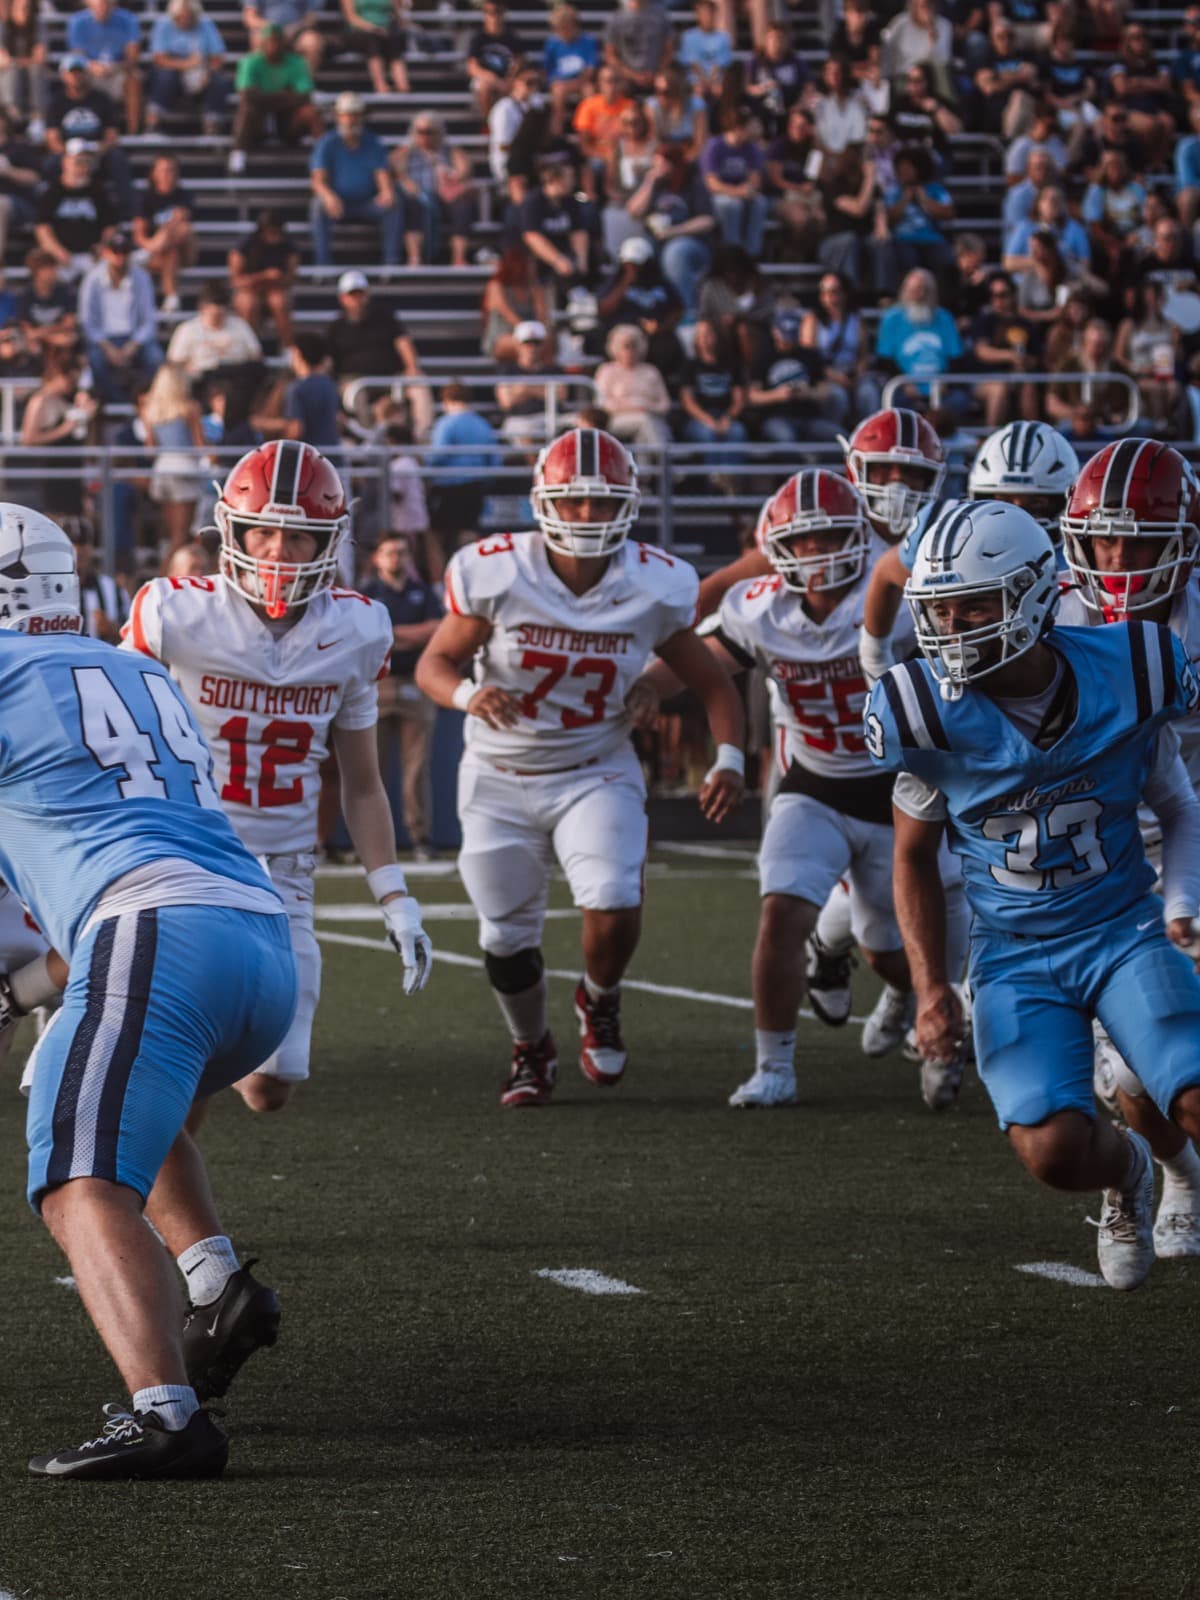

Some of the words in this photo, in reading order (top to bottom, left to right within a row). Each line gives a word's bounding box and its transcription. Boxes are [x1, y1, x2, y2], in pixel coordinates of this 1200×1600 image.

[28, 613, 82, 635] Riddel
[516, 623, 636, 655] SOUTHPORT
[199, 674, 339, 716] SOUTHPORT
[514, 650, 619, 730] 73
[785, 678, 870, 753] 55
[70, 666, 222, 810] 44
[218, 716, 315, 808] 12
[981, 797, 1111, 891] 33
